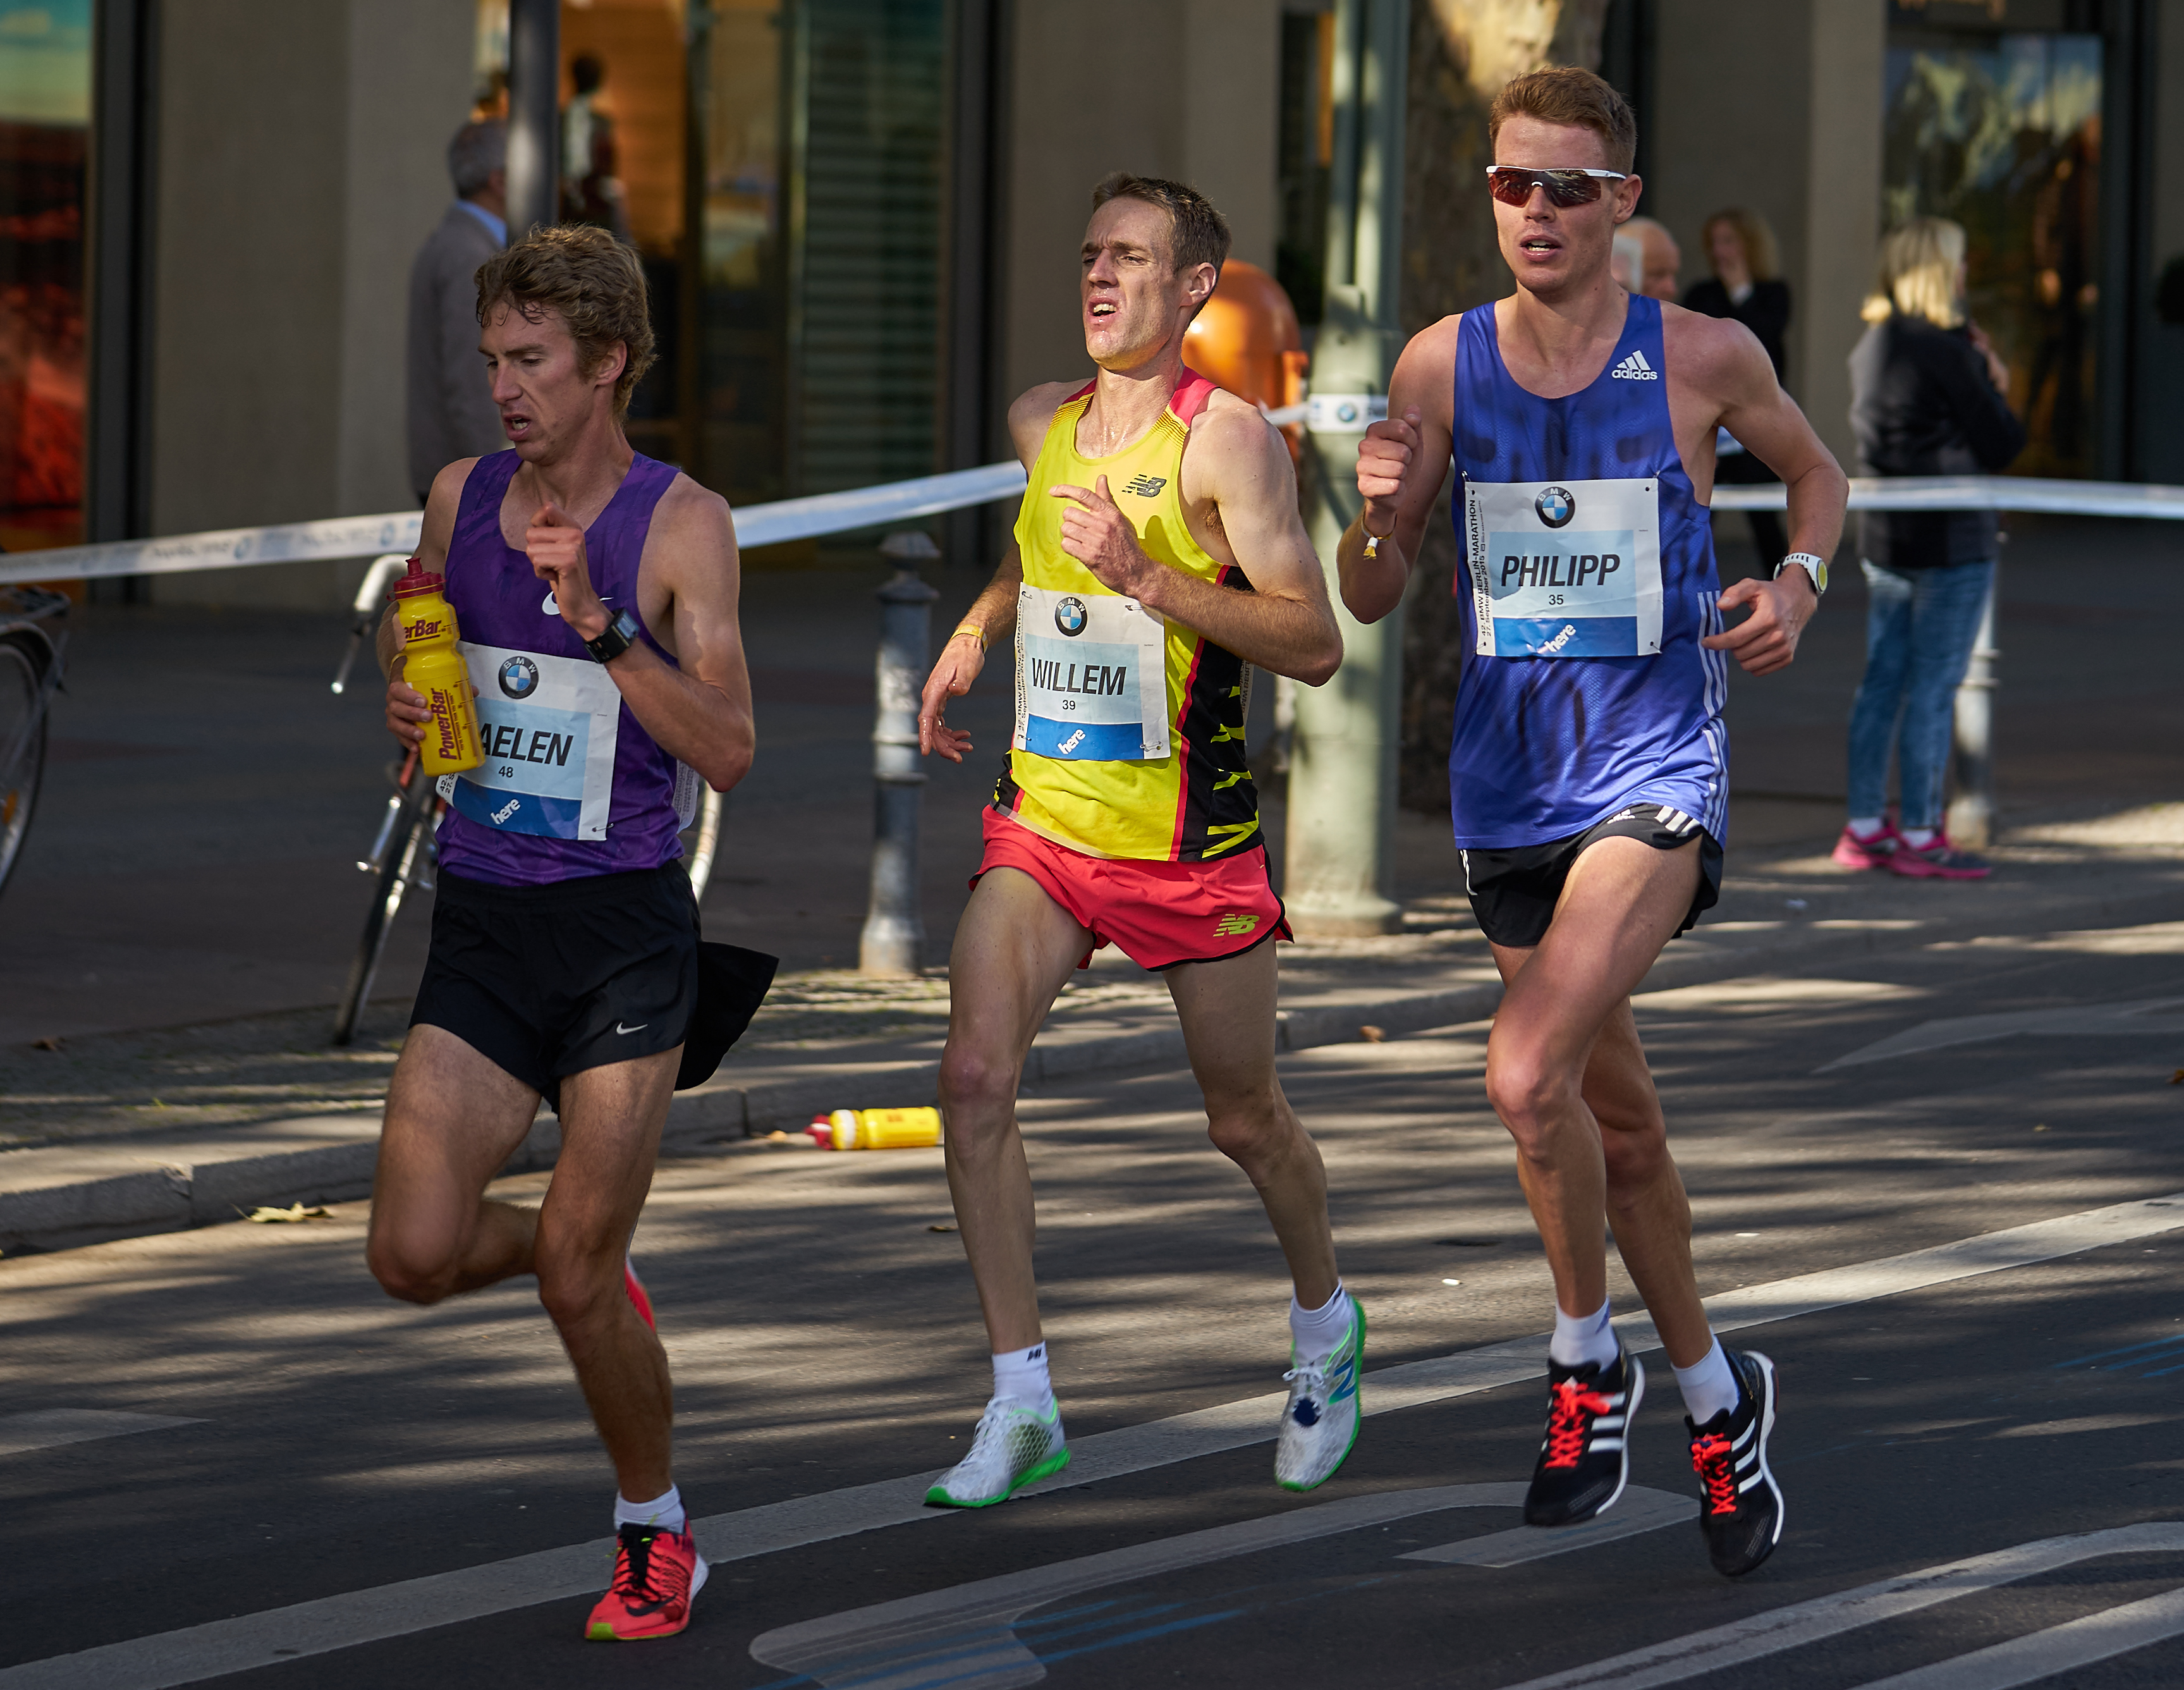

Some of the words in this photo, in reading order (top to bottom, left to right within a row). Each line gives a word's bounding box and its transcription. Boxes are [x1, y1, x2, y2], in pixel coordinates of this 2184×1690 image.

[1611, 368, 1658, 380] adidas
[1538, 487, 1572, 502] BMW
[1469, 499, 1484, 594] BERLIN-MARATHON
[1479, 555, 1487, 576] 2015
[1501, 554, 1621, 587] PHILIPP
[1057, 597, 1085, 613] BMW
[1548, 594, 1565, 605] 35
[1544, 623, 1577, 652] here
[503, 657, 537, 673] BMW
[1032, 658, 1127, 695] WILLEM
[1062, 699, 1076, 710] 39
[480, 723, 574, 767] AELEN
[1057, 728, 1086, 755] here
[498, 765, 514, 778] 48
[439, 778, 448, 792] 42.
[444, 781, 453, 794] 27.
[490, 798, 522, 825] here
